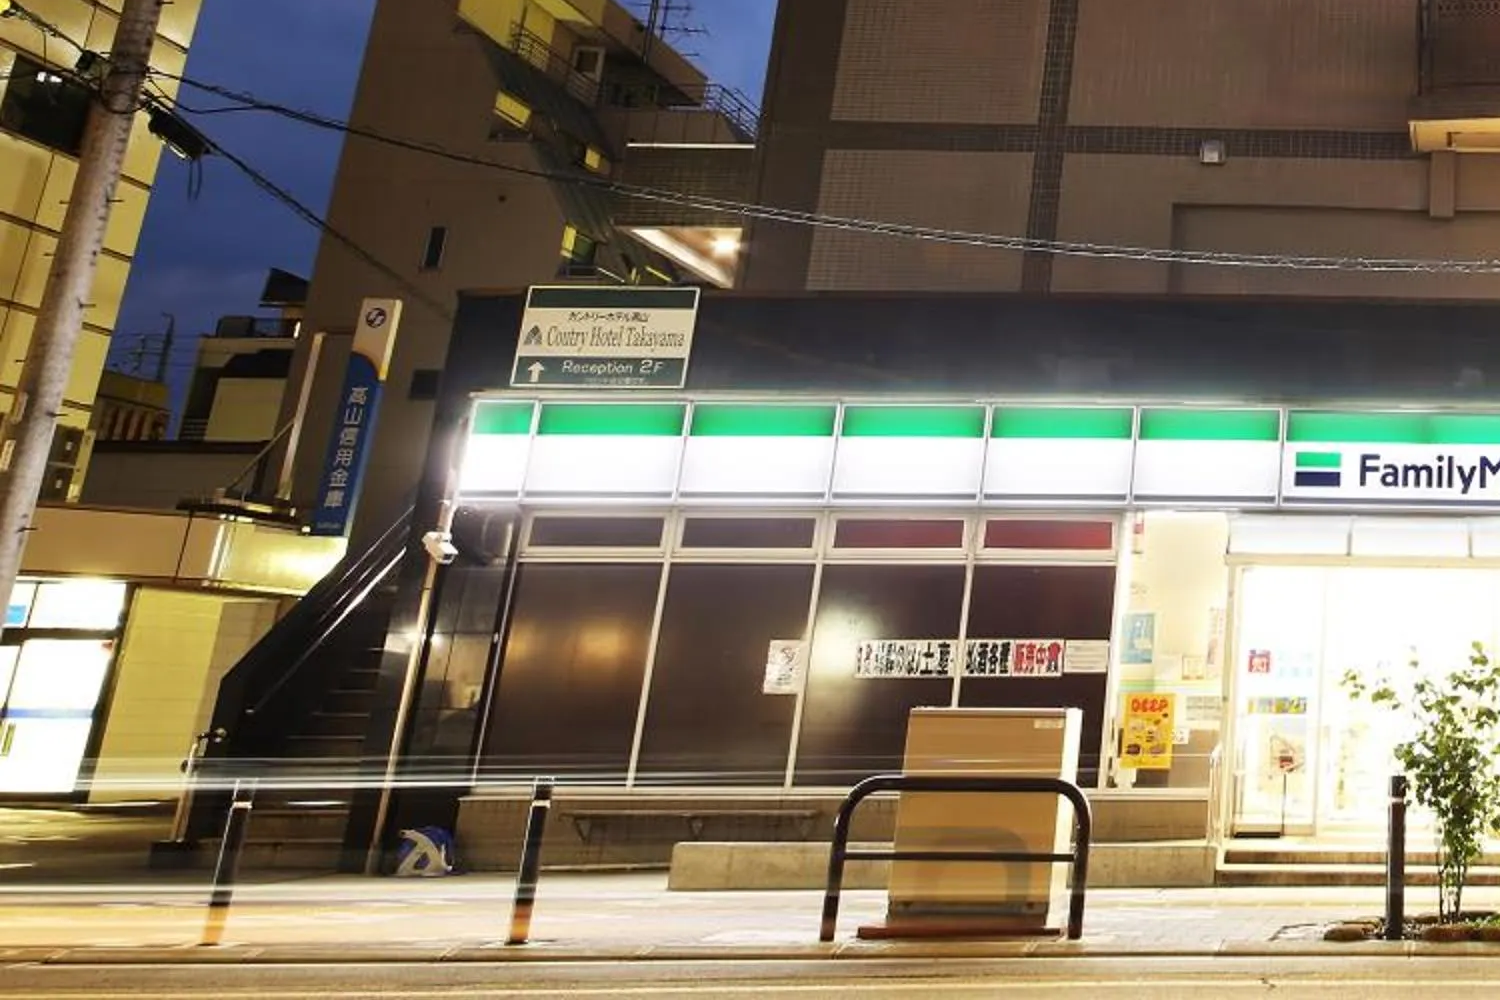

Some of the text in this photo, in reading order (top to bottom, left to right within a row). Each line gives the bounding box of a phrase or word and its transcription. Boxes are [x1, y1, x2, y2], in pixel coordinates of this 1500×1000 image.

[589, 326, 624, 348] Hotel
[625, 327, 685, 352] Takayama
[561, 359, 665, 376] Reception 2F
[324, 386, 369, 508] 高山信用金庫
